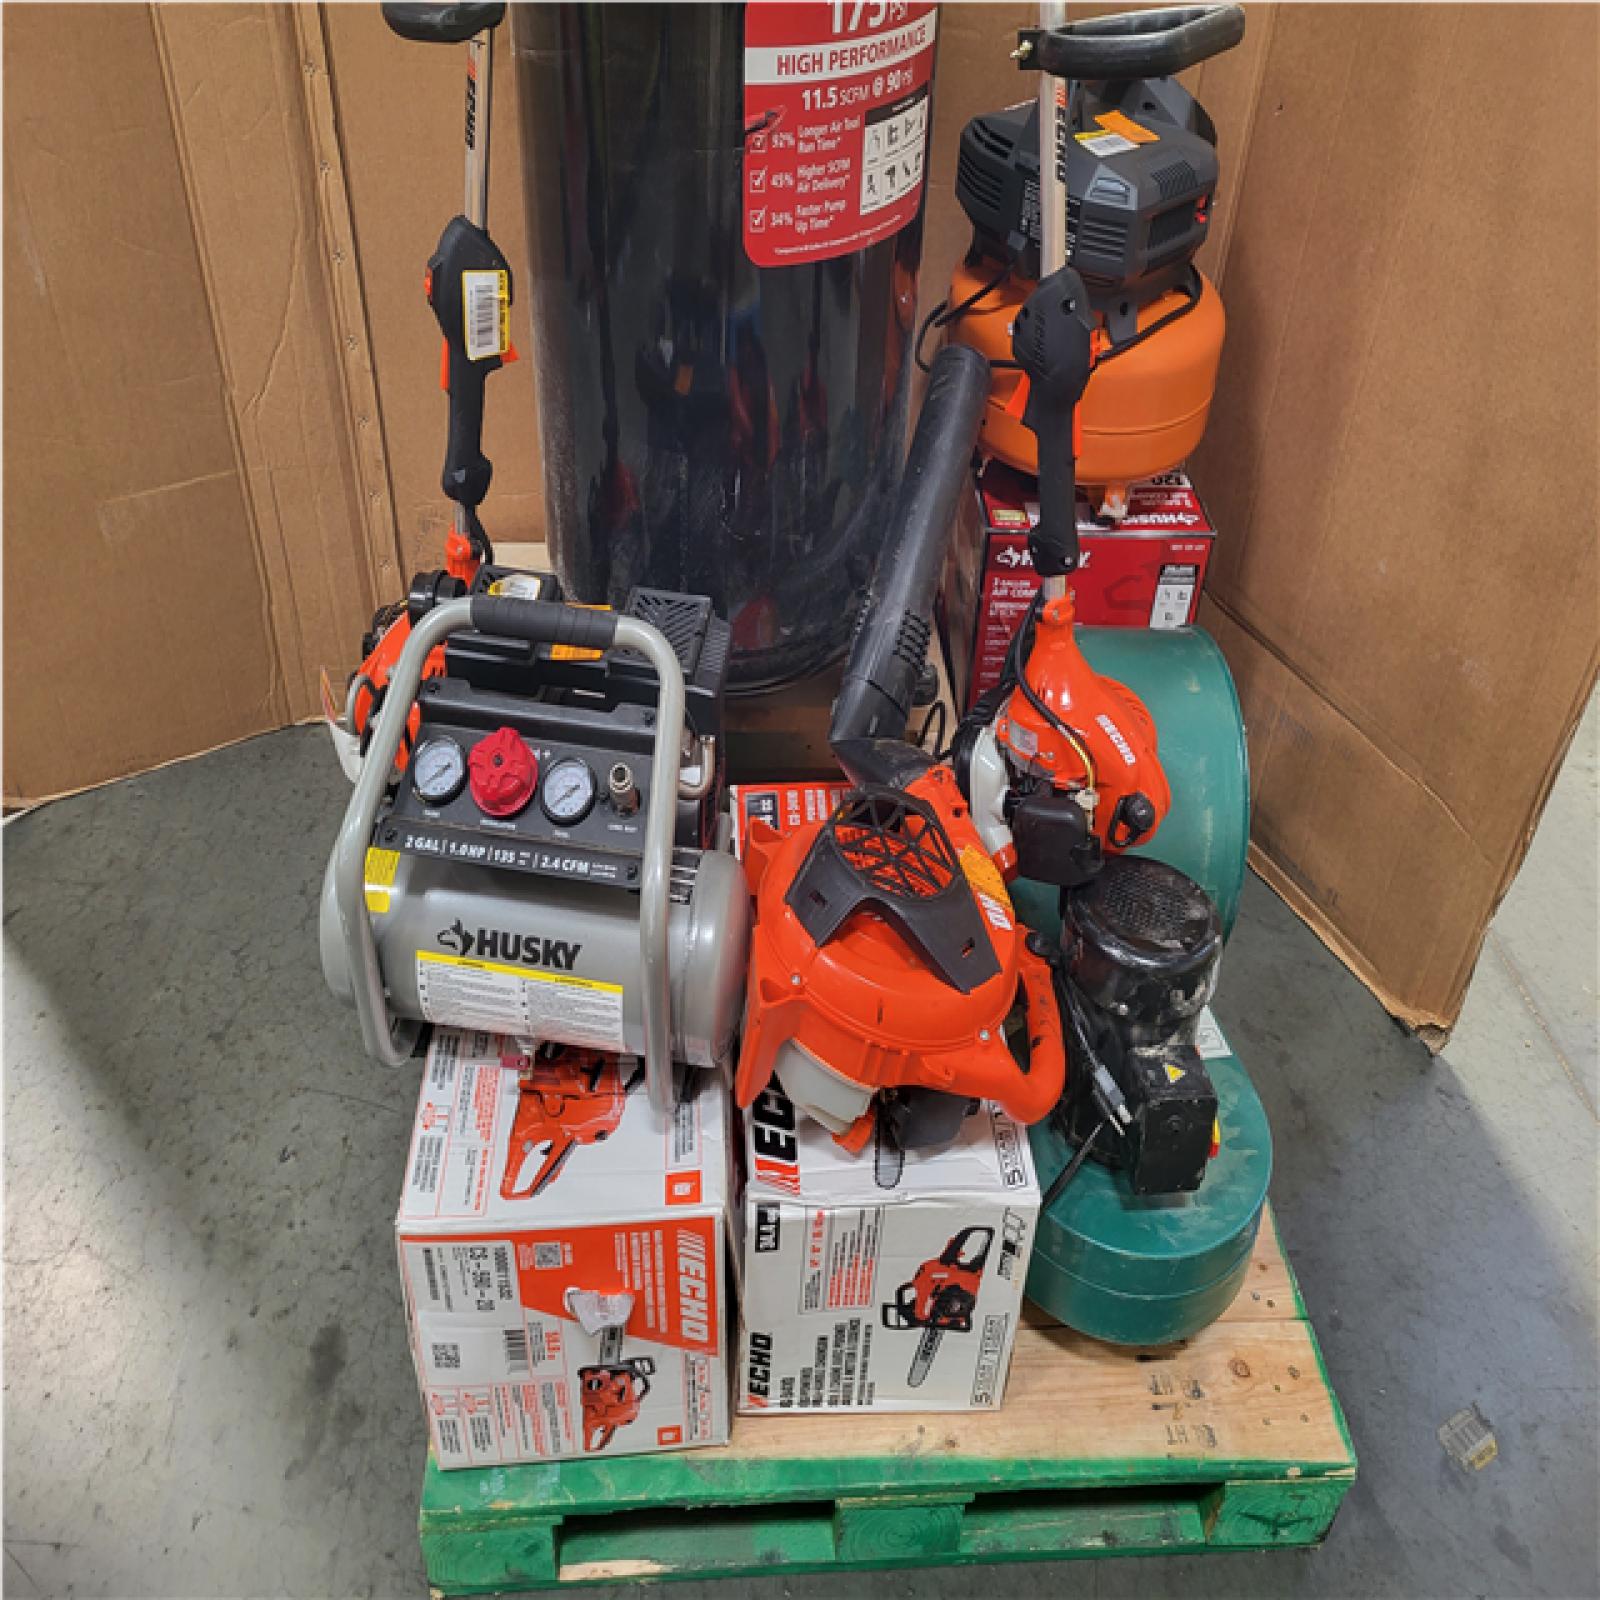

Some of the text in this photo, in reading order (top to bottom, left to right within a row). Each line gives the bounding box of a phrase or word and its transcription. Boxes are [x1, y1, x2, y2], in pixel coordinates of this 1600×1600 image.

[777, 24, 926, 75] HIGH PERFORMANCE
[802, 86, 838, 111] 11.5
[1055, 105, 1068, 184] ECHO
[414, 837, 440, 853] GAL
[562, 857, 589, 875] CFM
[477, 929, 583, 971] HUSKY
[678, 1256, 710, 1343] ECHO
[750, 1333, 773, 1396] ECHO
